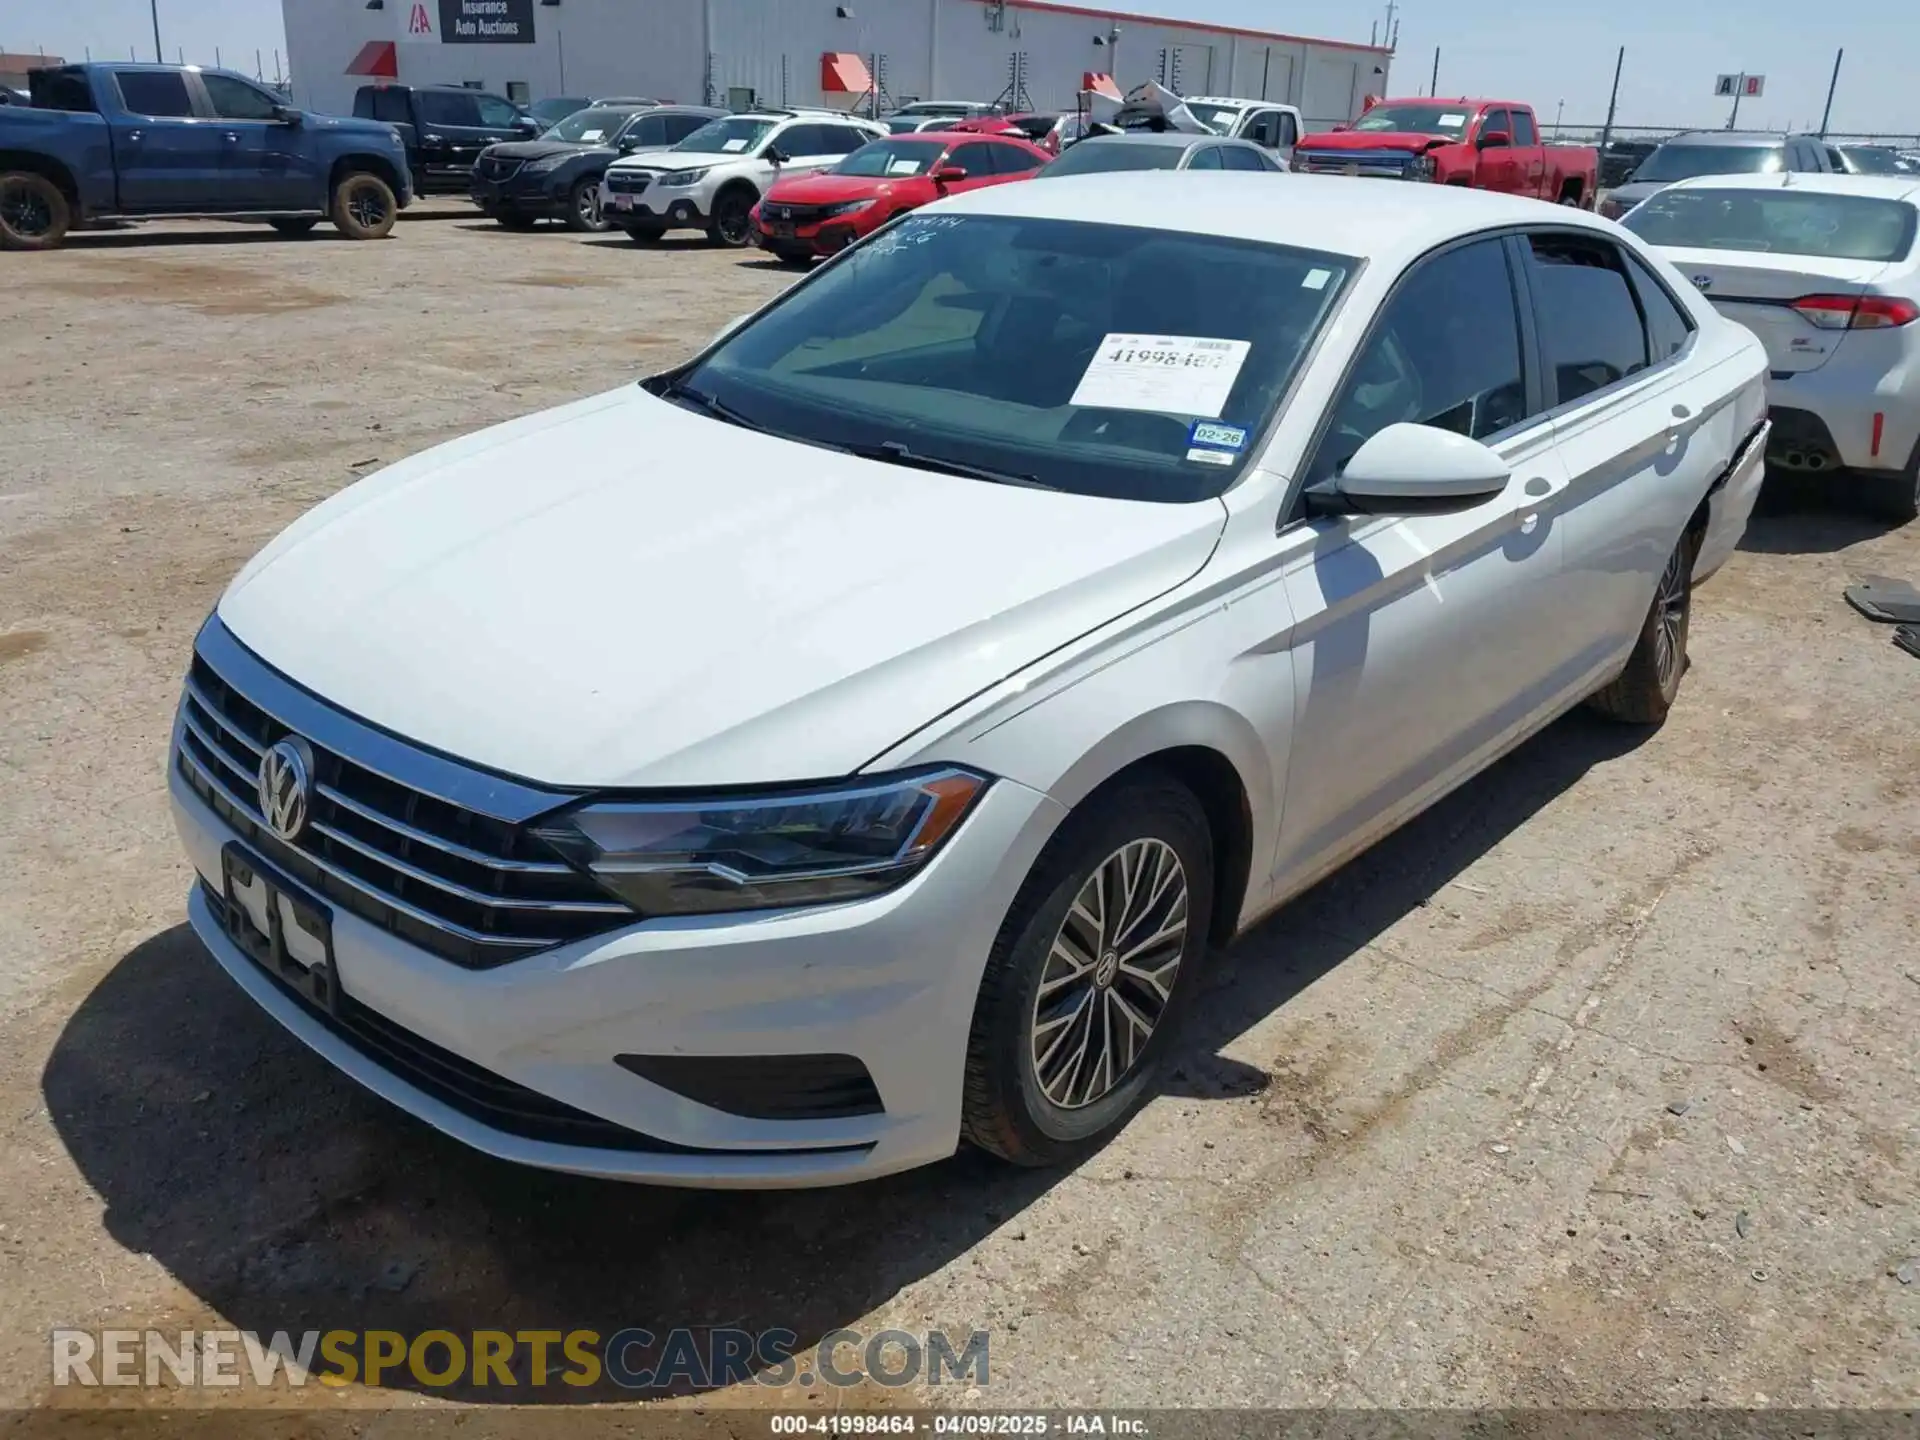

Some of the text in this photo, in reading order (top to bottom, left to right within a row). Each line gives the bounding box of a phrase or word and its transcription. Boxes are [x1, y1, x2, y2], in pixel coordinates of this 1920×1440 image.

[462, 0, 507, 14] Insurance
[455, 18, 519, 35] Auto Auctions
[1720, 77, 1731, 94] A
